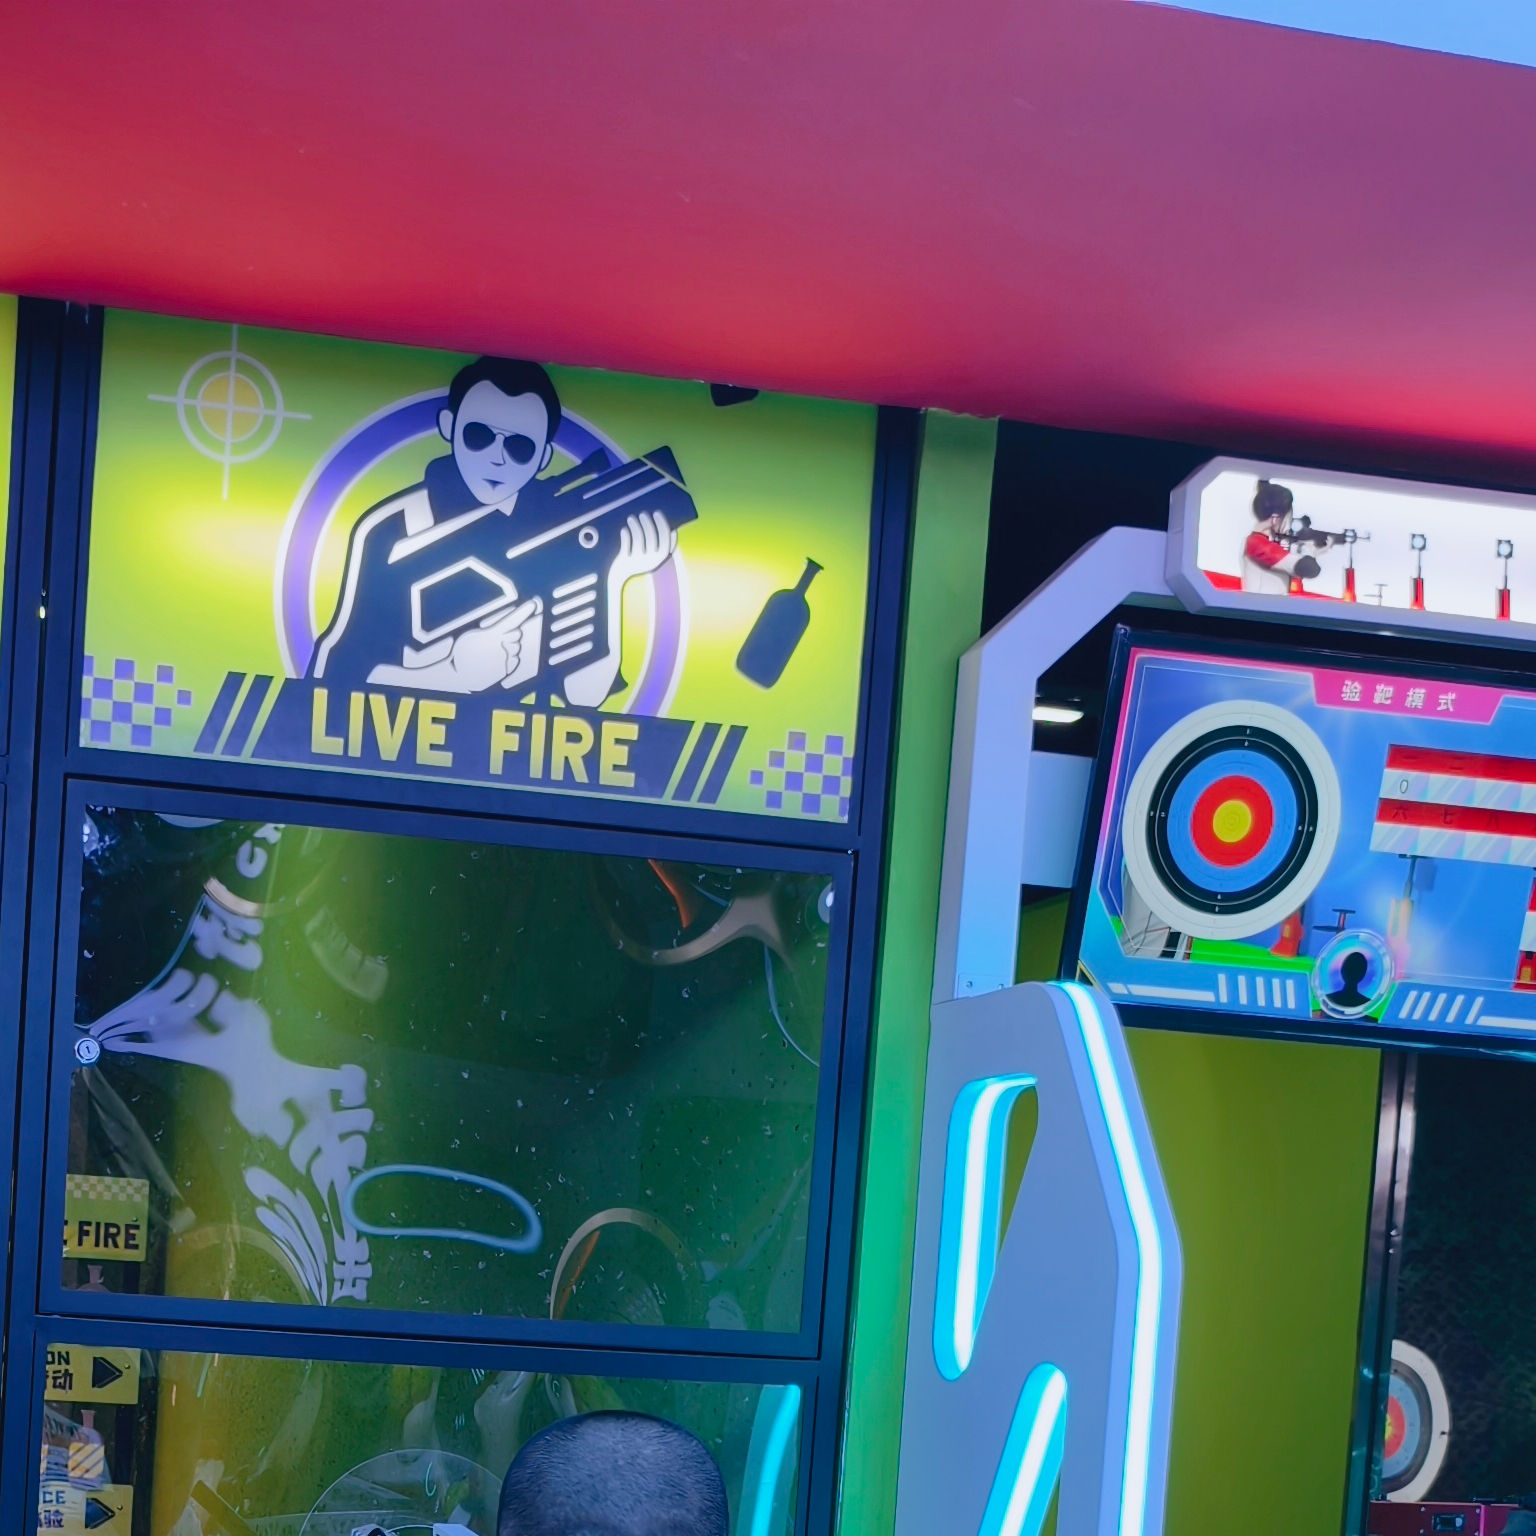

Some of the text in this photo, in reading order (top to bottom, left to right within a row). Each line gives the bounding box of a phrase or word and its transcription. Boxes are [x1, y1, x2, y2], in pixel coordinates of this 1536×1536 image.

[310, 688, 639, 788] LIVE FIRE
[77, 1220, 140, 1250] FIRE
